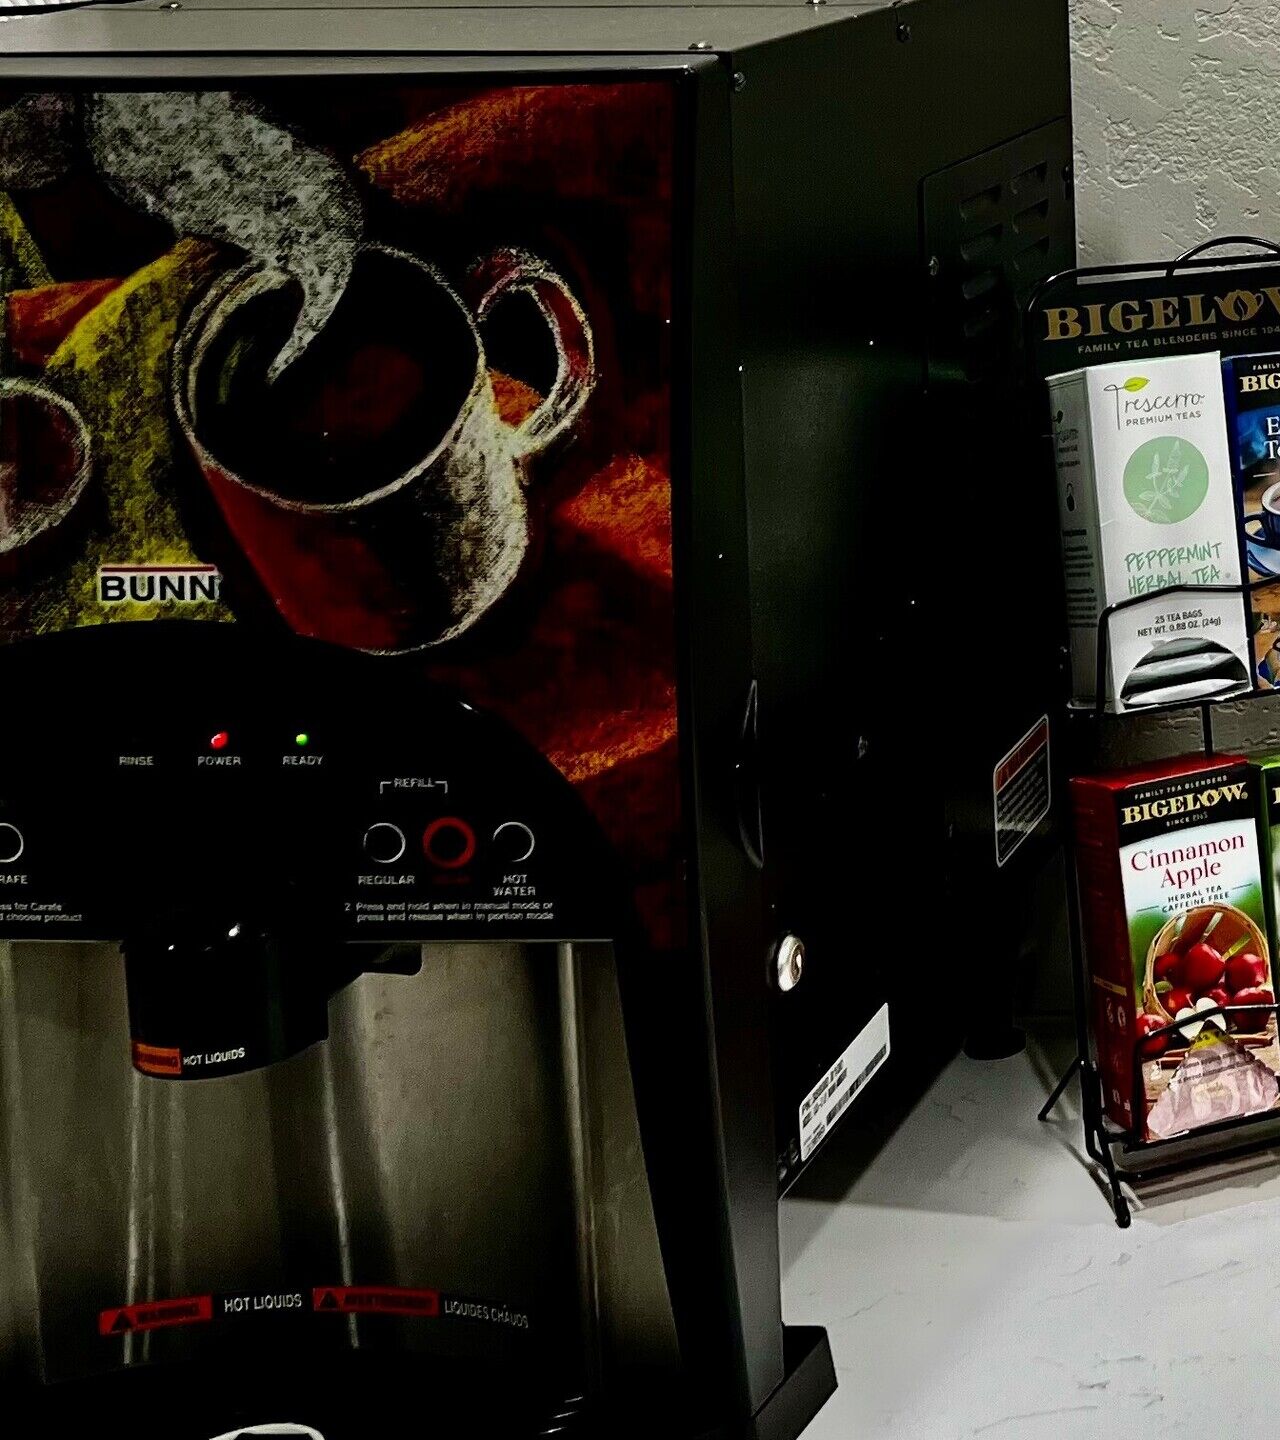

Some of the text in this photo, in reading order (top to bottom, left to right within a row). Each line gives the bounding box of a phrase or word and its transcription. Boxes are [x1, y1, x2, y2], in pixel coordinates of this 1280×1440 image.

[1078, 342, 1120, 354] FAMILY
[1126, 339, 1147, 349] TEA
[1153, 331, 1217, 346] BLENDERS
[1222, 327, 1258, 339] SINCE
[1252, 362, 1280, 371] FAMILY
[1126, 410, 1201, 426] PREMIUM TEAS
[1124, 541, 1222, 572] PEPPERMINT
[100, 575, 216, 601] BUNN
[1128, 564, 1220, 595] HERBAL TEA
[1155, 609, 1203, 624] 25 TEA BAGS
[1137, 627, 1152, 637] NET
[1154, 625, 1168, 634] WT.
[1170, 622, 1186, 632] 0.88
[1202, 616, 1221, 628] (24g)
[119, 755, 324, 766] RINSE POWER READY
[394, 778, 436, 788] REFILL
[1134, 789, 1164, 800] FAMILY
[1167, 785, 1182, 793] TEA
[1121, 782, 1246, 825] BIGELOW
[1131, 834, 1245, 871] Cinnamon
[357, 875, 416, 885] REGULAR
[502, 874, 528, 884] HOT
[1161, 858, 1221, 889] Apple
[493, 887, 536, 896] WATER
[1168, 885, 1222, 903] HERBAL TEA
[1162, 891, 1230, 913] CAFFEINE FREE
[183, 1054, 202, 1066] HOT
[205, 1047, 245, 1065] LIQUIDS
[224, 1293, 302, 1313] HOT LIQUIDS
[445, 1300, 489, 1320] LIQUIDES
